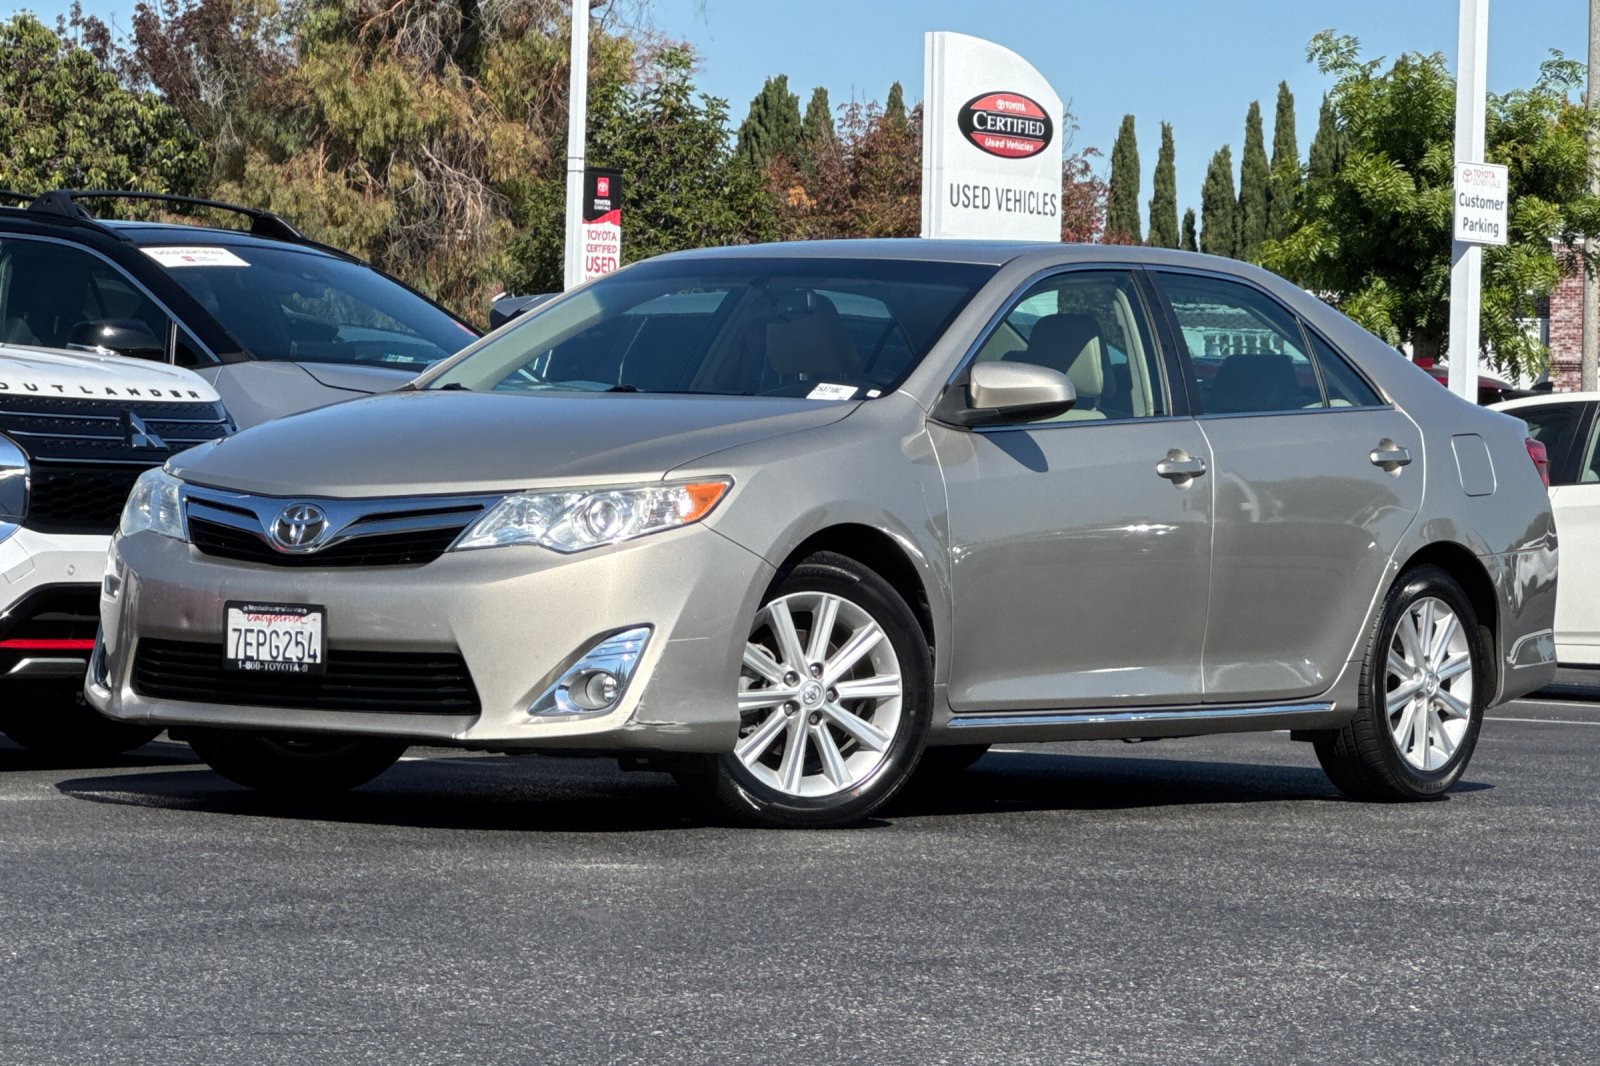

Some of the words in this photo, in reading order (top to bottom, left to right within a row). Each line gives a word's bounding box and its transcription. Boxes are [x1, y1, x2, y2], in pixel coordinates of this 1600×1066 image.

[1005, 101, 1026, 112] TOYOTA
[973, 111, 1044, 136] CERTIFIED
[985, 137, 1005, 148] Used
[1006, 140, 1034, 152] Vehicles
[1474, 169, 1496, 180] TOYOTA
[950, 183, 991, 210] USED
[995, 187, 1057, 217] VEHICLES
[1459, 192, 1505, 211] Customer
[1463, 217, 1499, 238] Parking
[587, 230, 617, 242] TOYOTA
[586, 243, 617, 254] CERTIFIED
[585, 256, 617, 273] USED
[247, 613, 307, 628] California
[232, 627, 318, 663] 7EPG254
